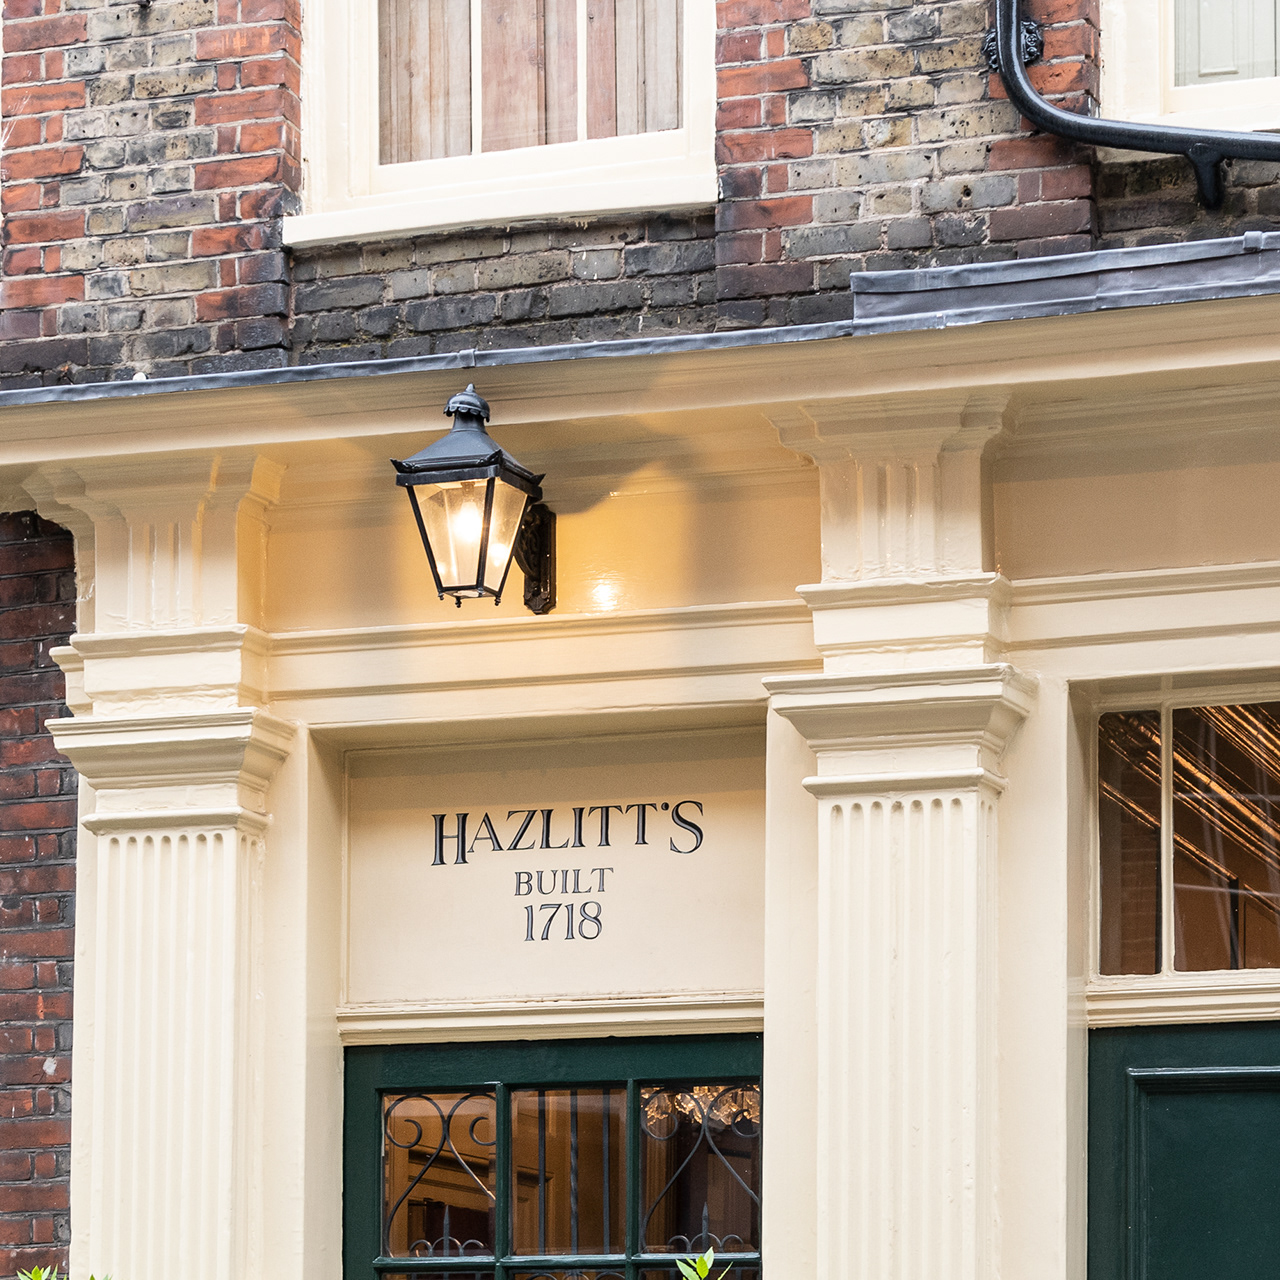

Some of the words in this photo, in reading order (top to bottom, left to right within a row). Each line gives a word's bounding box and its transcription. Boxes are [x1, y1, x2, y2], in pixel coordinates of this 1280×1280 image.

[431, 800, 704, 866] HAZLITT'S
[514, 867, 614, 897] BUILT
[524, 901, 603, 941] 1718
